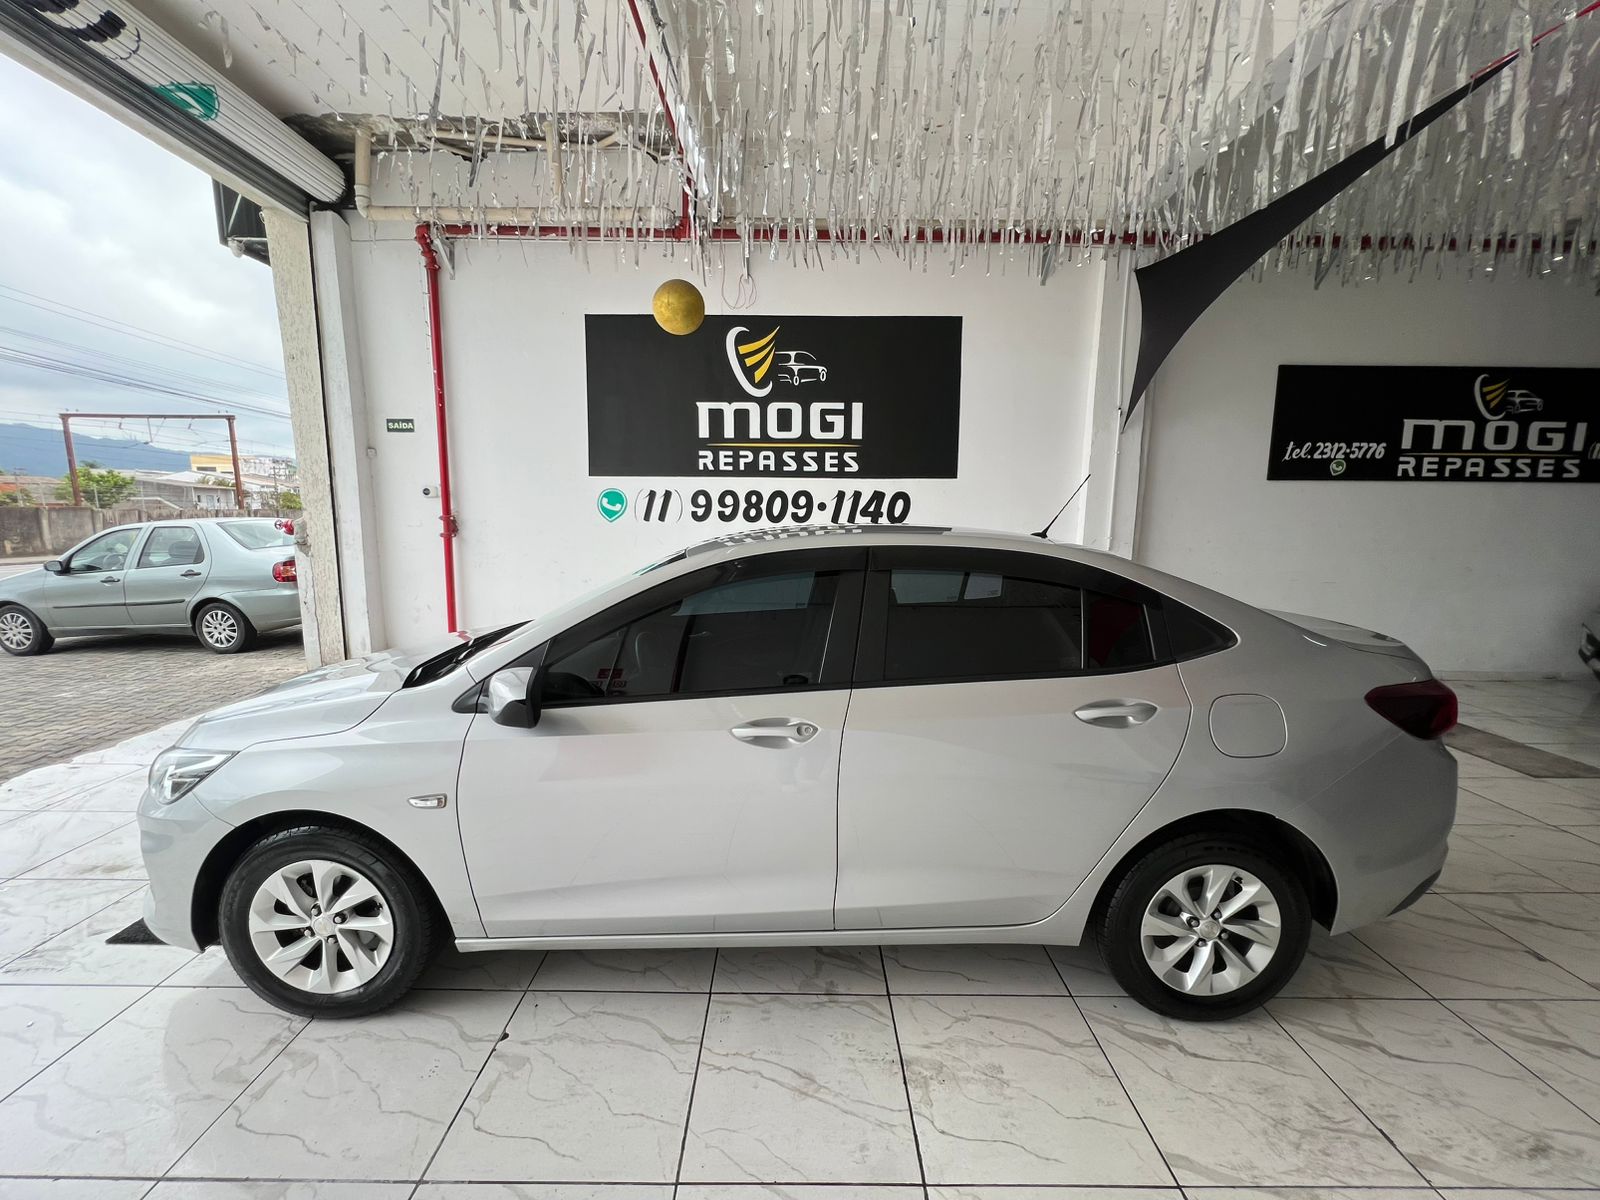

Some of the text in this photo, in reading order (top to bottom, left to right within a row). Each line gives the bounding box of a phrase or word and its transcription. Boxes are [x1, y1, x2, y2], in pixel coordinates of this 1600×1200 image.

[389, 421, 413, 429] SAÍDA
[695, 402, 863, 440] MOGI
[1401, 419, 1588, 451] MOGI
[698, 450, 860, 473] REPASSES
[1397, 457, 1581, 478] REPASSES
[634, 489, 684, 523] (11)
